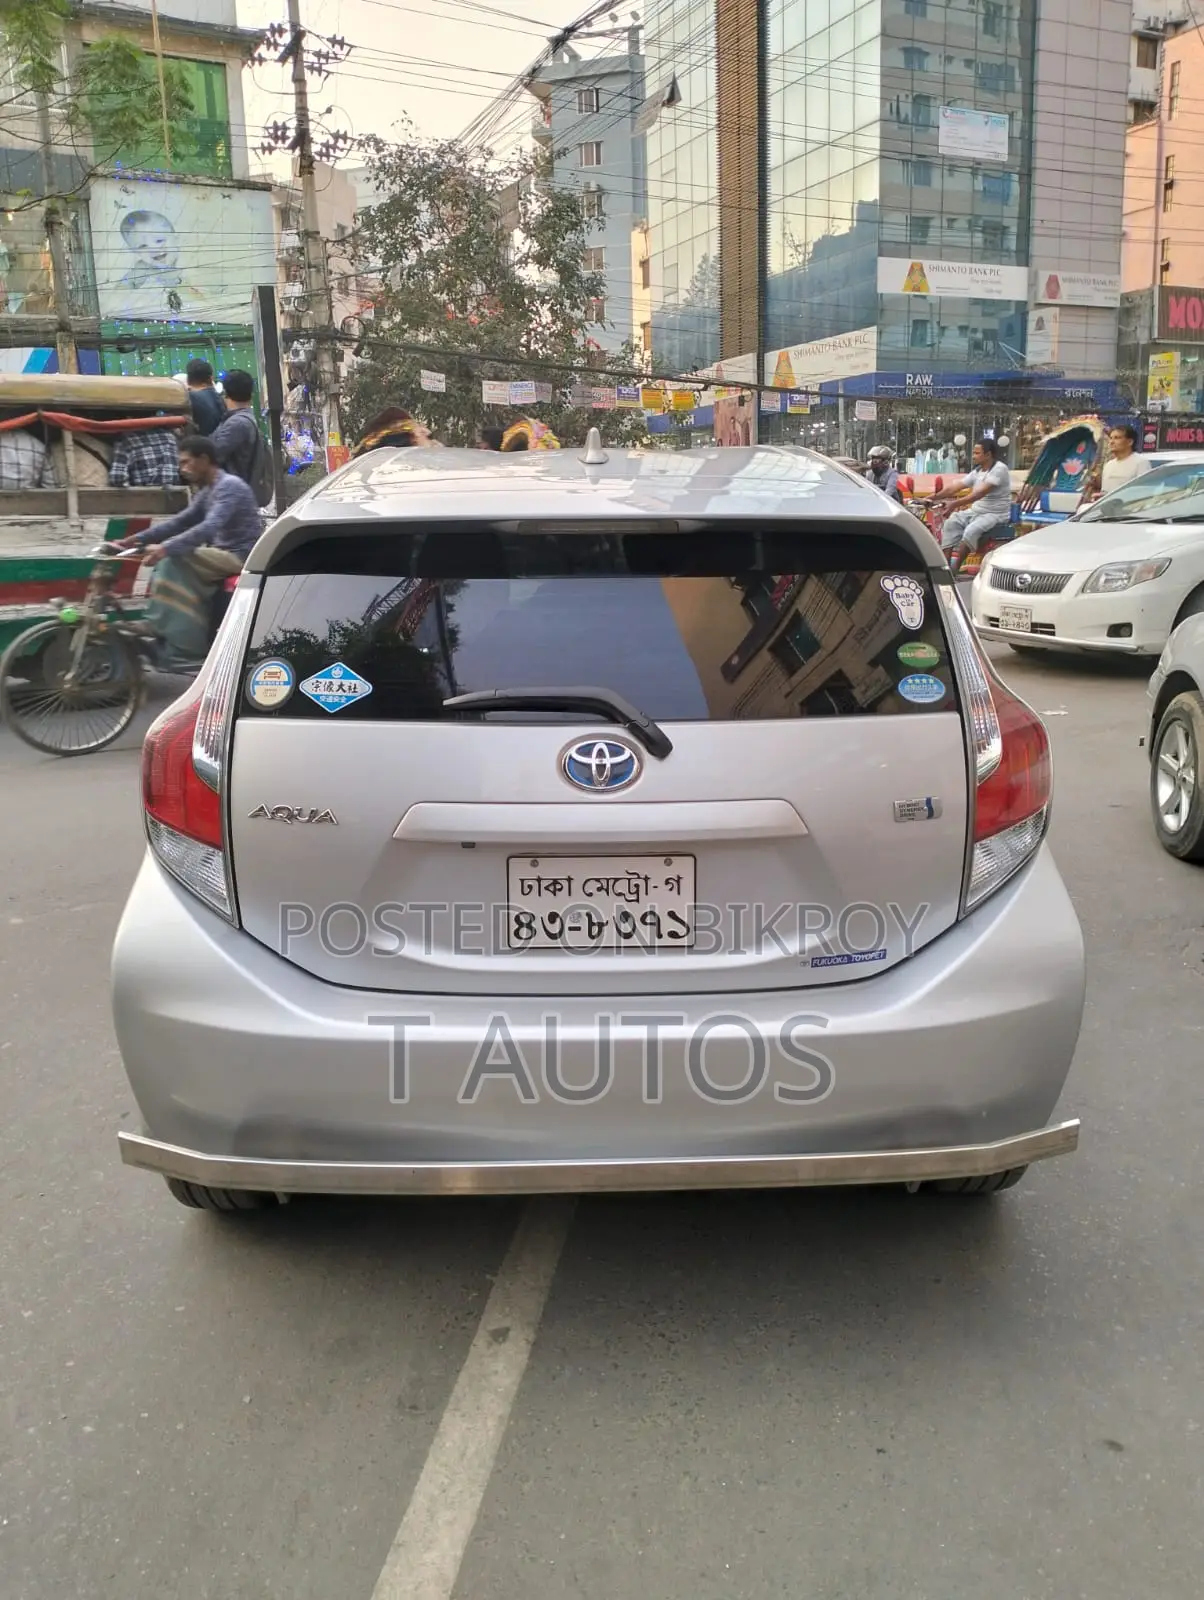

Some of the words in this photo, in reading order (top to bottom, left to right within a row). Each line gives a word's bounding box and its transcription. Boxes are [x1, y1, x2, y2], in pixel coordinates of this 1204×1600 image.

[928, 264, 967, 275] SHIMANTO
[968, 266, 988, 276] BANK
[1168, 295, 1204, 329] MO
[793, 342, 831, 360] SHIMANTO
[832, 337, 853, 352] BANK
[895, 592, 915, 600] Baby
[247, 802, 339, 826] AQUA
[519, 875, 574, 897] ঢাকা
[513, 910, 691, 941] ৪৩-৮৩৭১
[812, 955, 848, 967] FUKUOKA
[851, 950, 885, 963] TOYOPET
